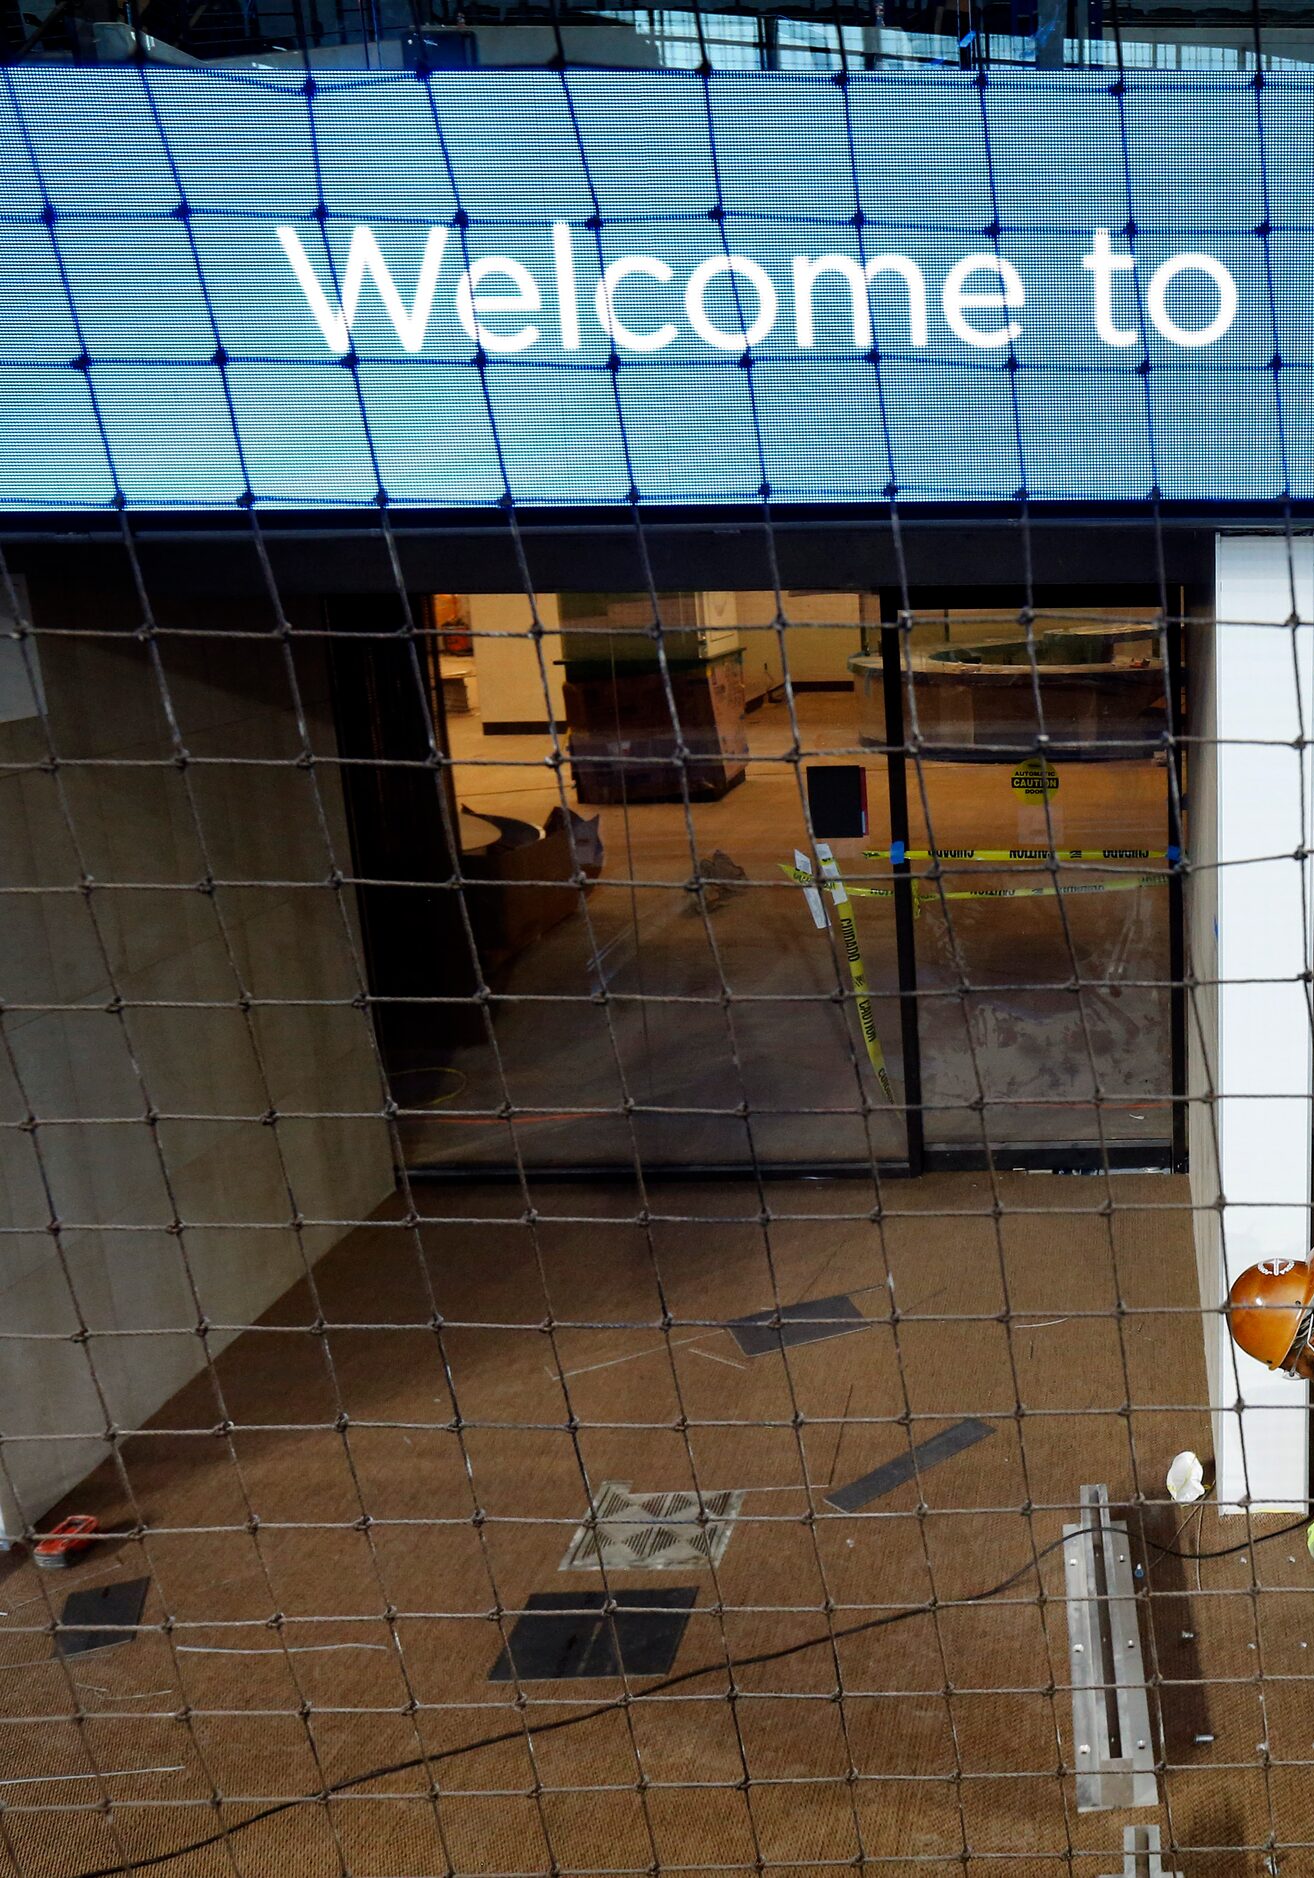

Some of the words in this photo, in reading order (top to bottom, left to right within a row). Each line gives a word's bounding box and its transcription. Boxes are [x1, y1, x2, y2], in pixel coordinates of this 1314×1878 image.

[277, 223, 1024, 351] Welcome
[1084, 230, 1236, 345] to
[1013, 778, 1057, 787] CAUTION
[1009, 850, 1052, 859] AUTION
[841, 917, 861, 963] CUIDADO
[859, 999, 877, 1043] CAUTION
